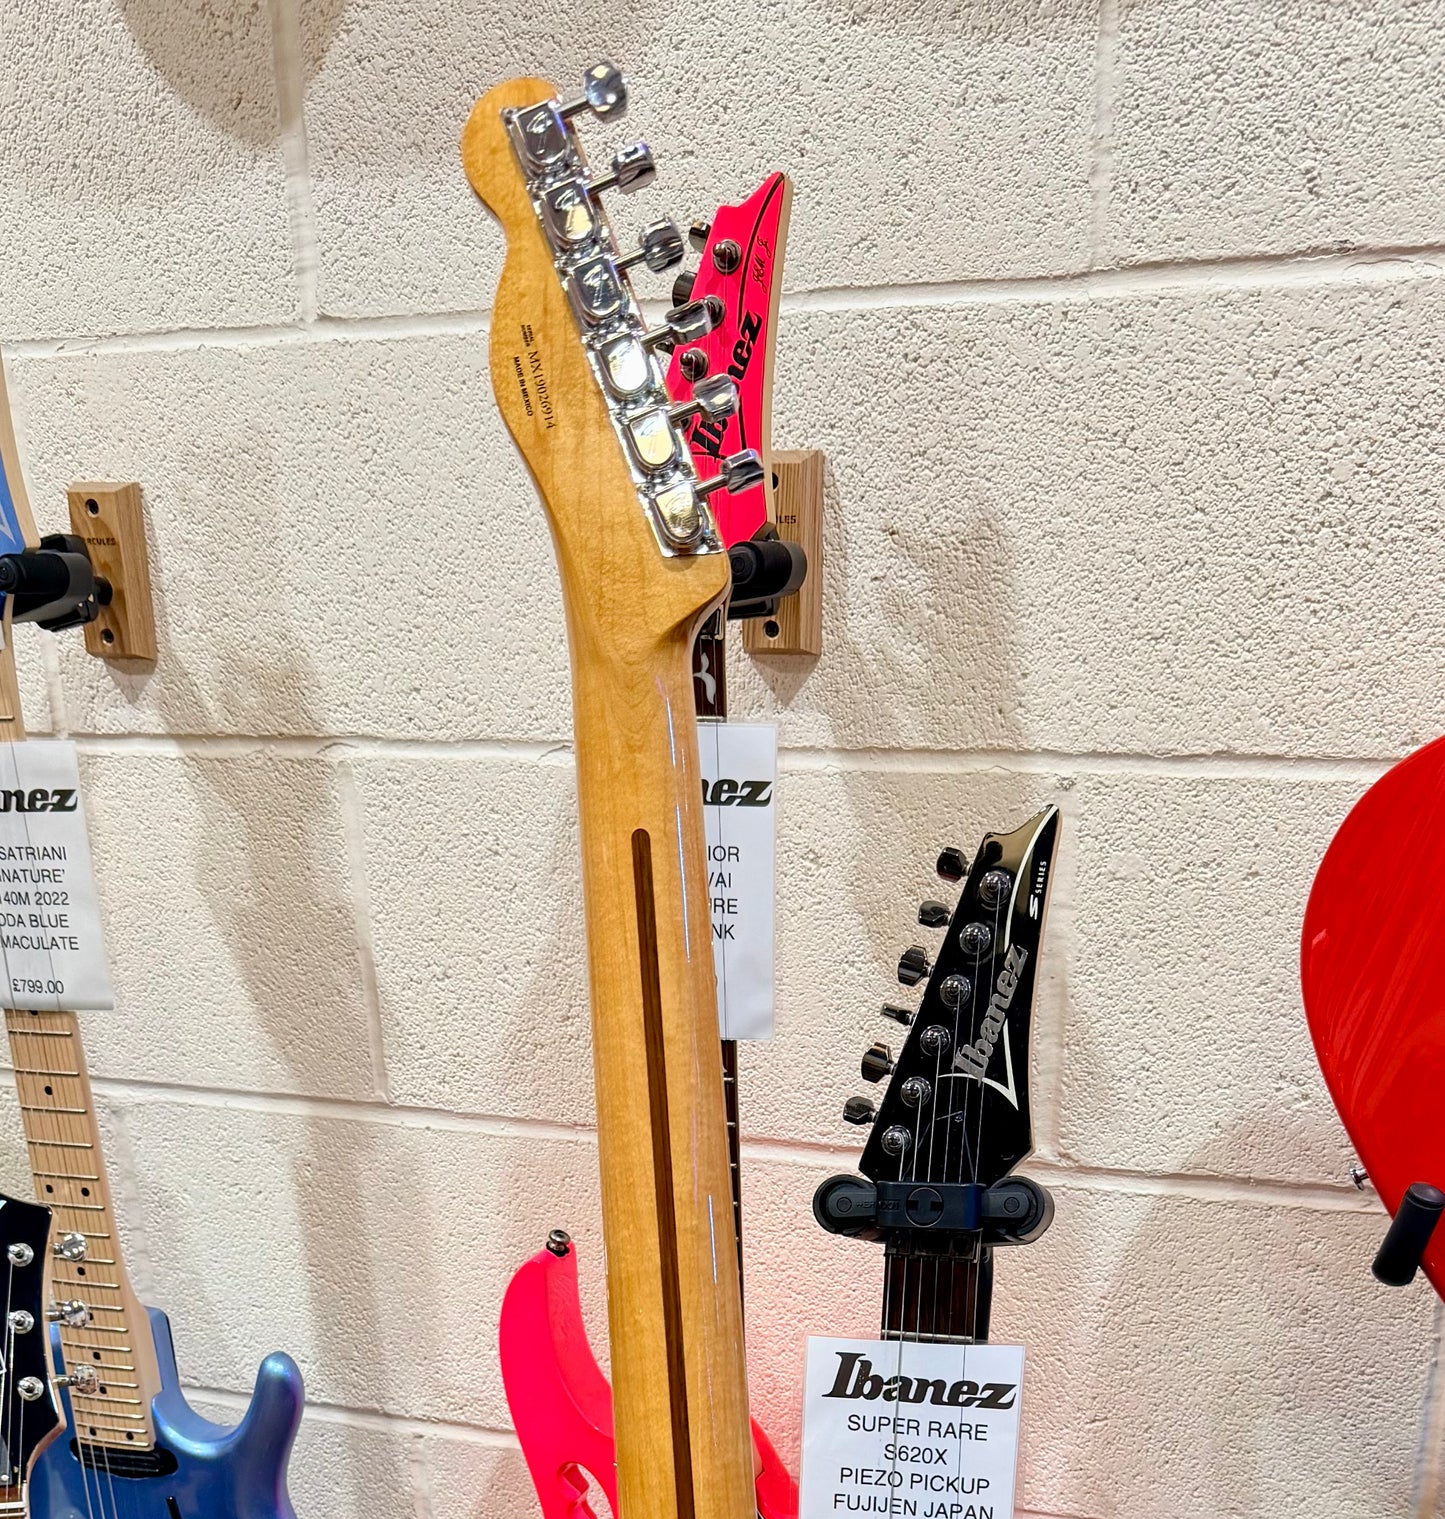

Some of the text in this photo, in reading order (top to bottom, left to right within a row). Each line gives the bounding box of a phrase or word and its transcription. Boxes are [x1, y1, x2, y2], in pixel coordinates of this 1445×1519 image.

[513, 356, 524, 378] MADE
[521, 387, 533, 416] MEXICO
[528, 350, 556, 429] MX19026914
[0, 788, 78, 812] nez
[0, 869, 65, 883] NATURE'
[1035, 861, 1047, 893] SERIES
[0, 891, 70, 905] 40M 2022
[710, 898, 738, 914] RE
[29, 914, 69, 928] BLUE
[13, 979, 64, 994] £799.00
[952, 943, 1028, 1086] Ibanez
[821, 1351, 1018, 1410] Ibanez
[847, 1415, 988, 1441] SUPER RARE
[884, 1444, 948, 1465] S620X
[840, 1468, 990, 1495] PIEZO PICKUP
[833, 1494, 917, 1516] FUJIJEN
